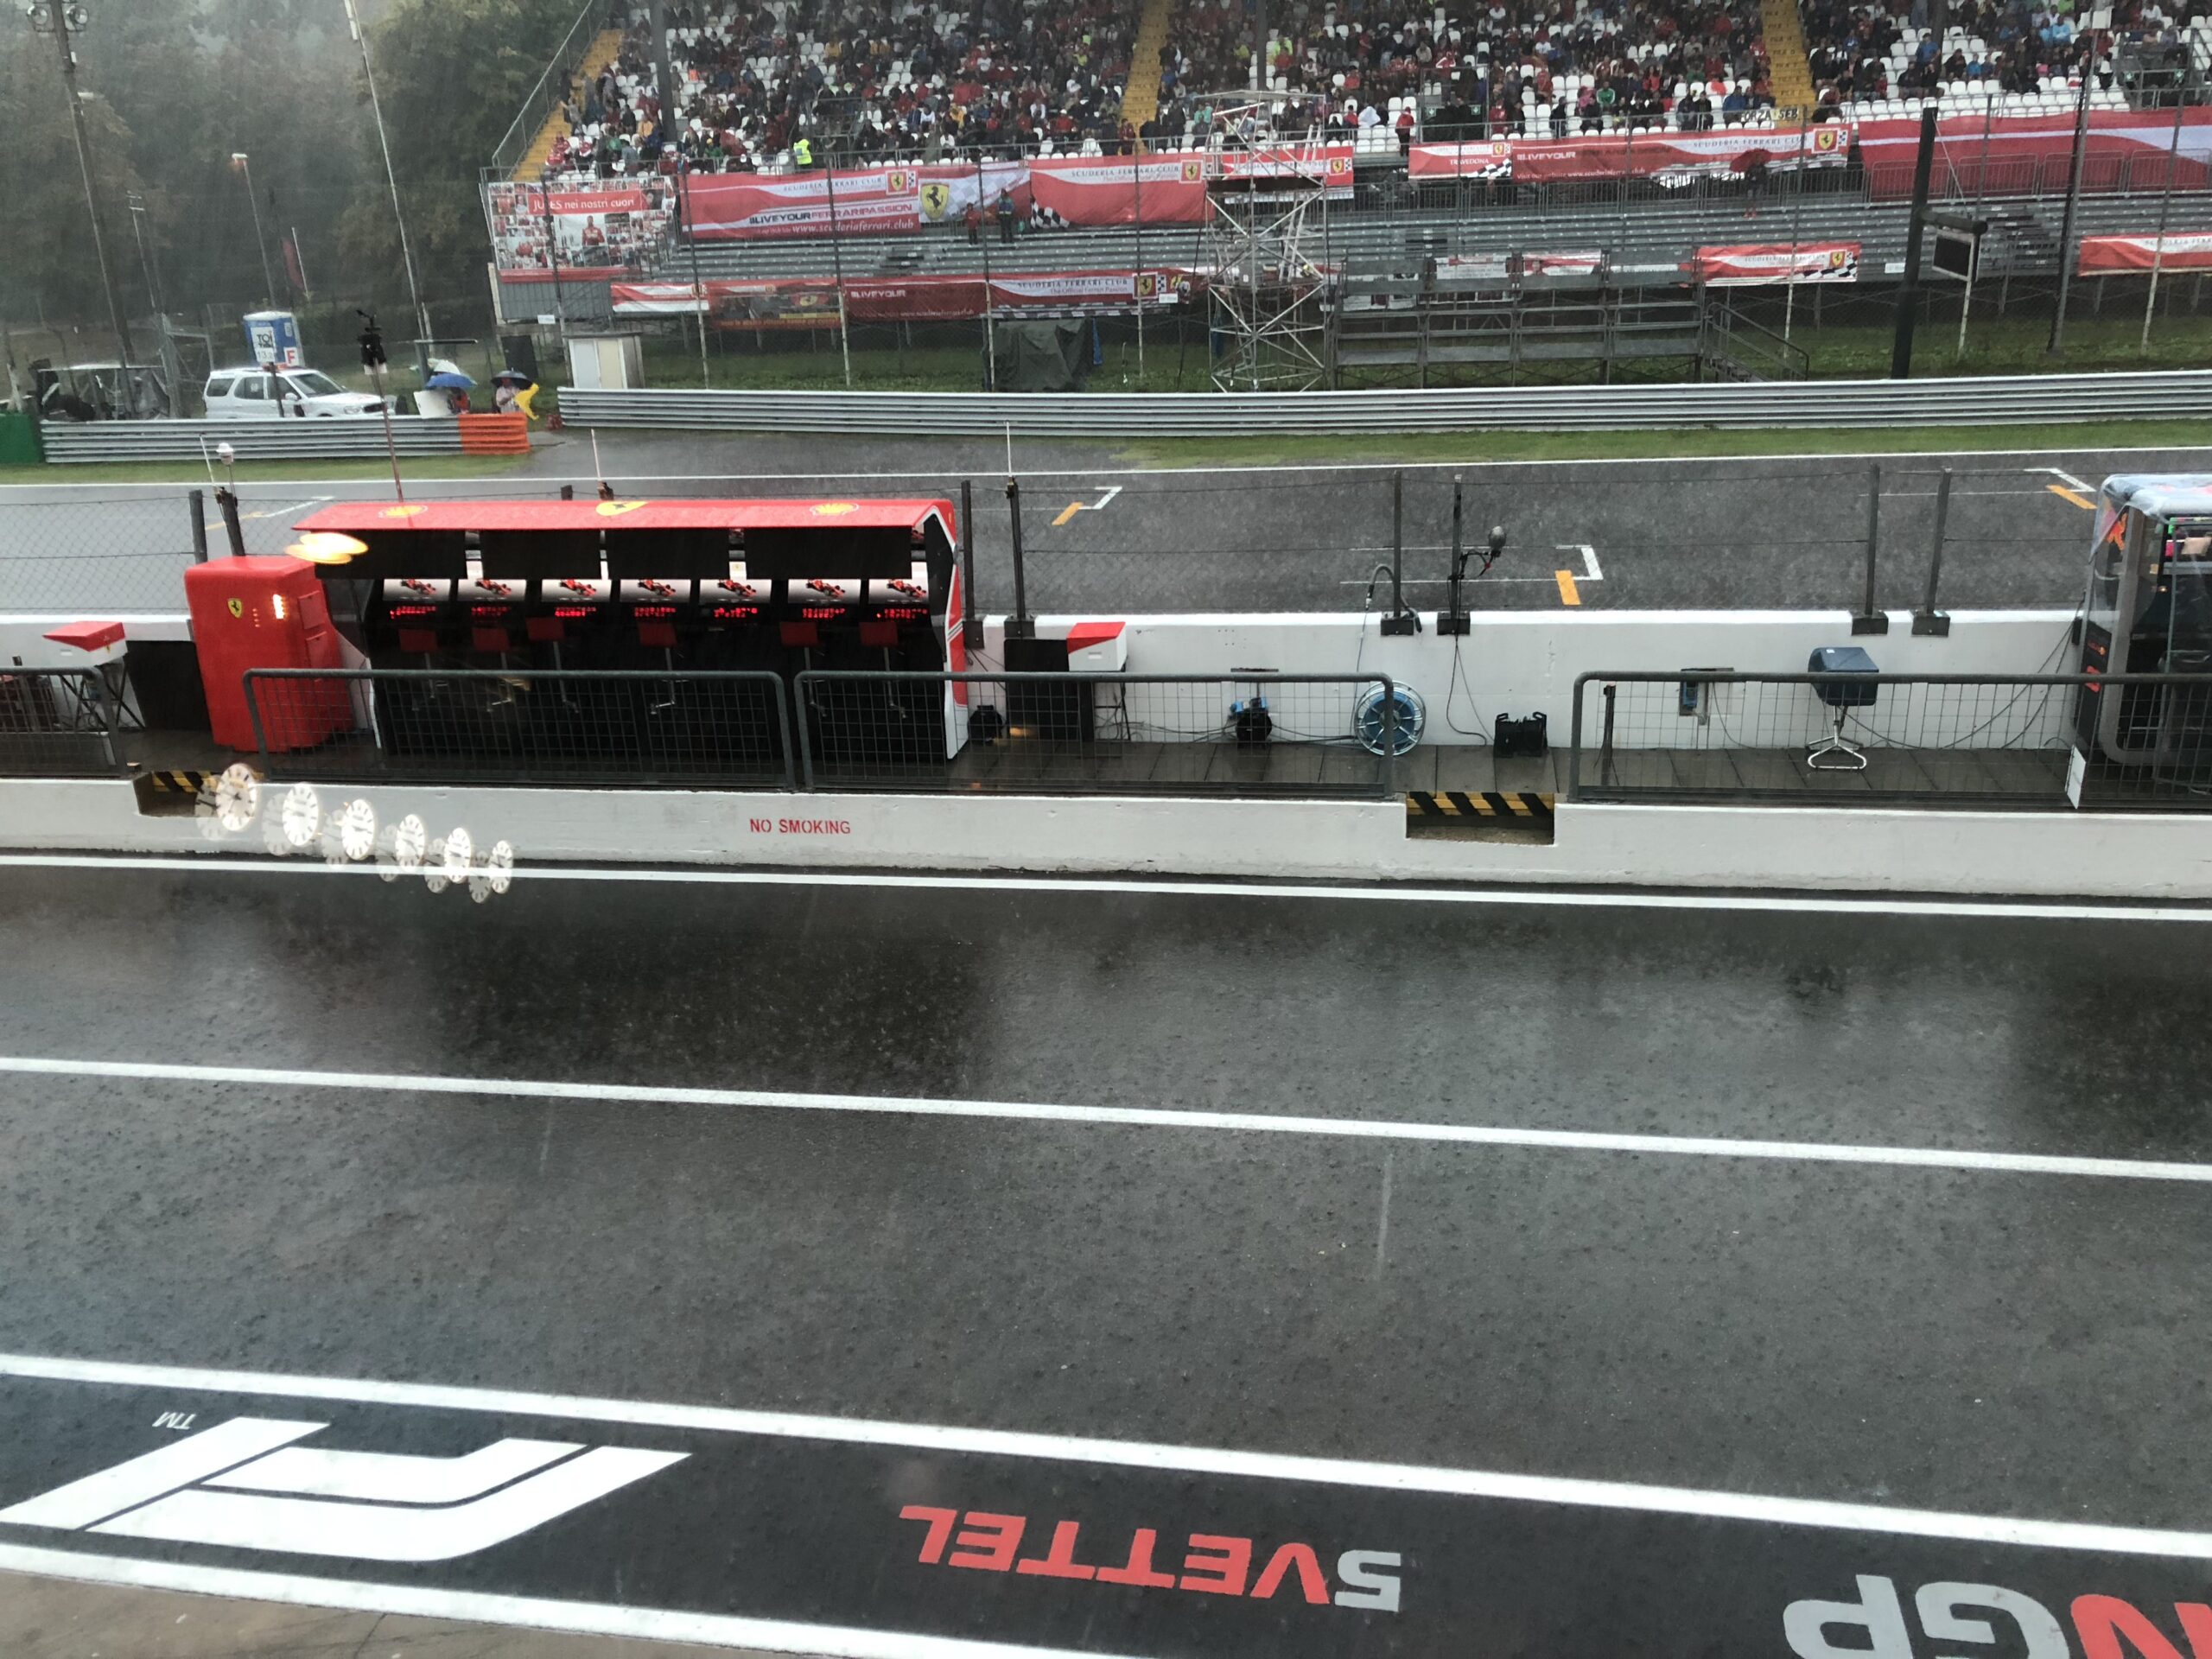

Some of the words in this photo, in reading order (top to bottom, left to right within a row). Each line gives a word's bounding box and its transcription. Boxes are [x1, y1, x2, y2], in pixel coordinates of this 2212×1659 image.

[1118, 167, 1153, 175] FERARI
[826, 179, 858, 188] FRRARI
[533, 200, 563, 212] JUES
[564, 199, 579, 209] nei
[581, 197, 608, 208] nostri
[610, 195, 635, 207] cuori
[750, 818, 772, 833] NO
[779, 818, 851, 835] SMOKING
[152, 1412, 196, 1430] TM
[899, 1505, 1331, 1605] VETTEL
[1334, 1549, 1402, 1612] 5
